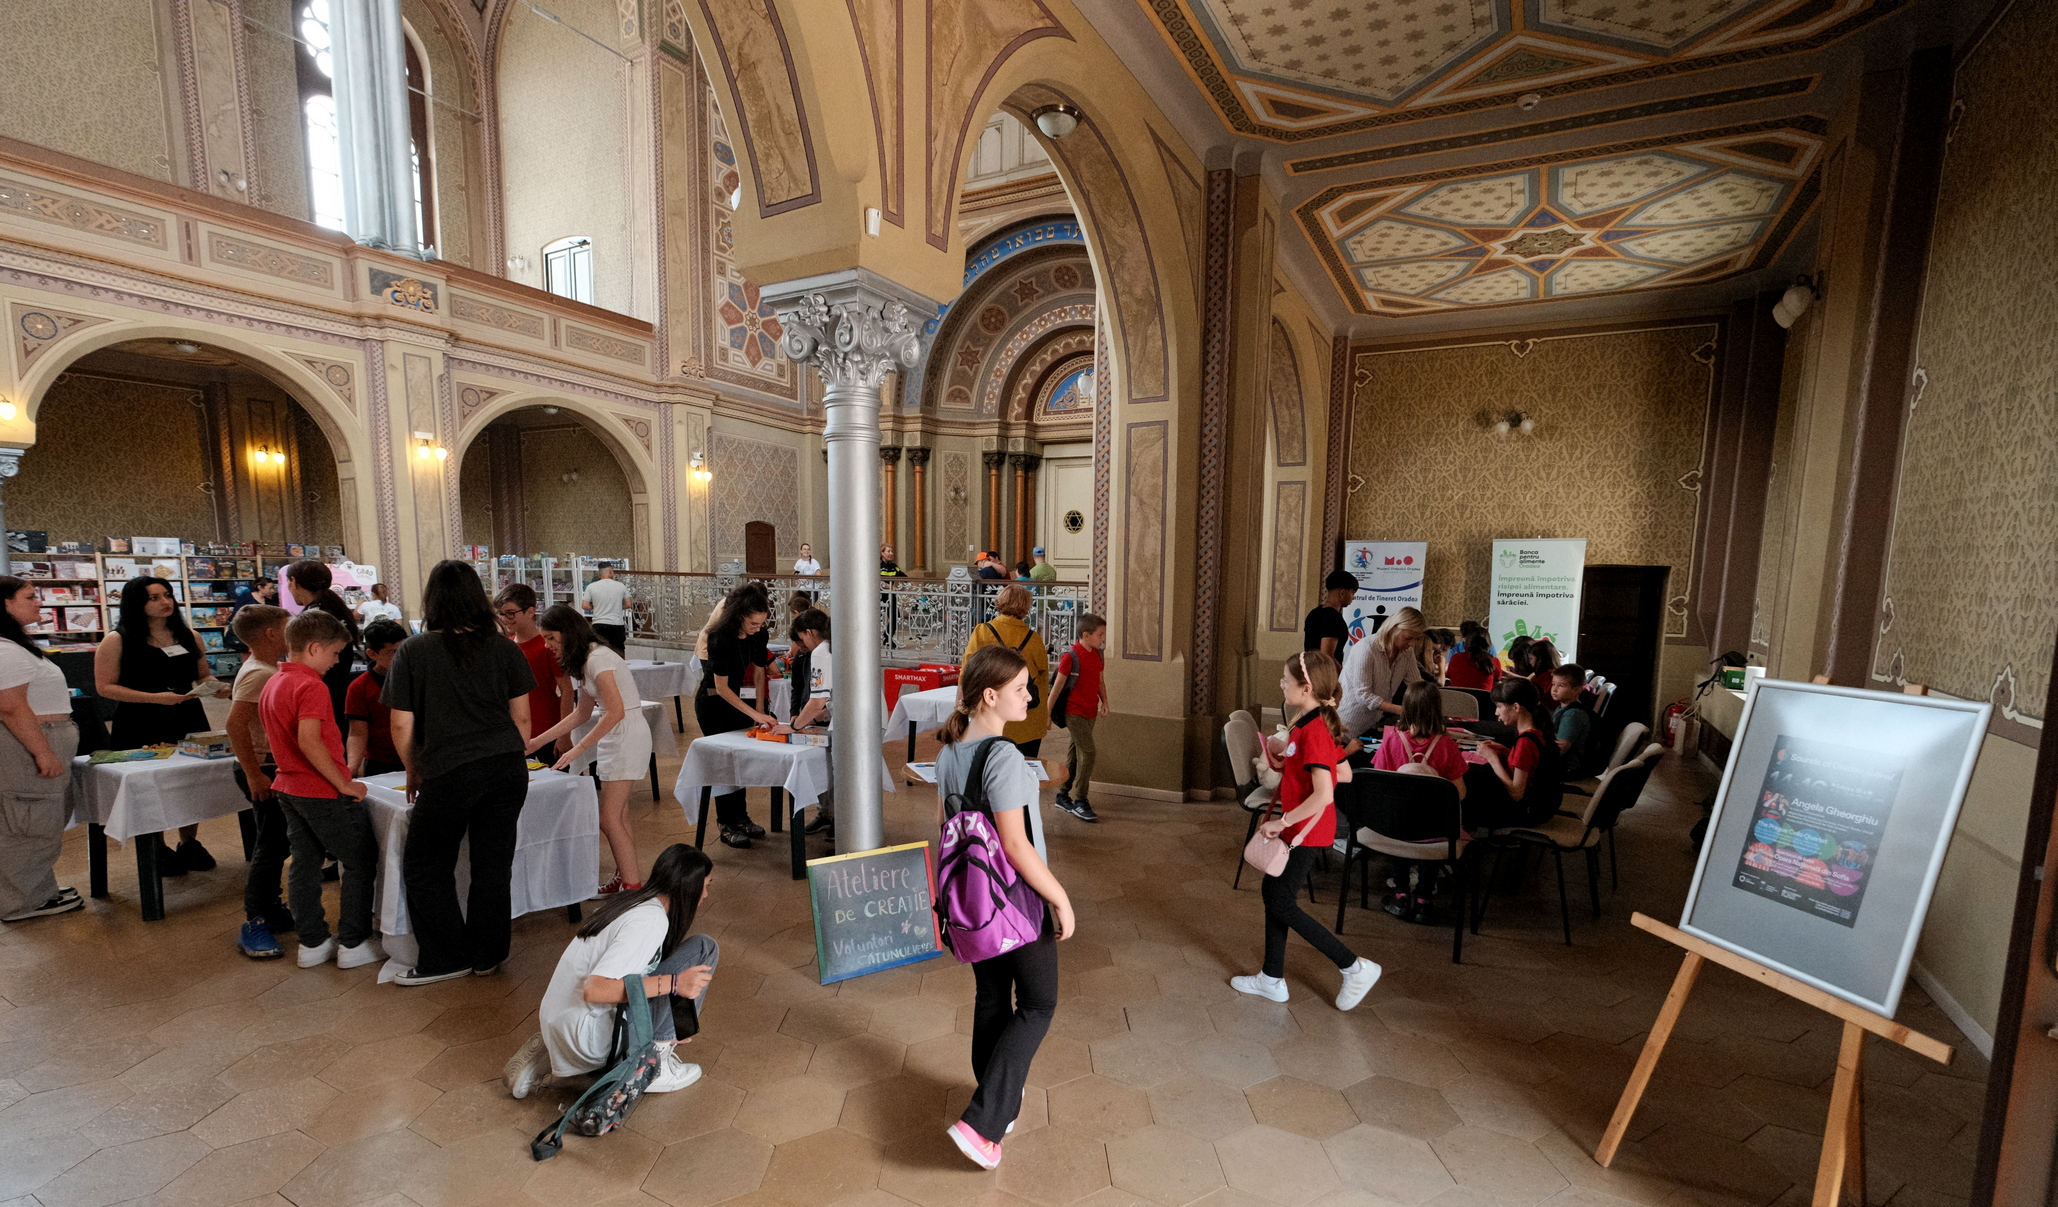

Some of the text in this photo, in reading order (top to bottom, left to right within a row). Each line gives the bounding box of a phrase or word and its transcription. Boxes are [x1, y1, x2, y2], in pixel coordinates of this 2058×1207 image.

[1498, 574, 1576, 583] Împreună împotriva
[1497, 583, 1522, 591] risipei
[1497, 590, 1575, 599] Împreună împotriva
[894, 674, 927, 682] SMARTMAX
[1790, 753, 1820, 766] Sounds
[1821, 759, 1832, 768] of
[1790, 797, 1824, 813] Angela
[1825, 806, 1879, 826] Gheorghiu
[1757, 819, 1768, 828] The
[1774, 854, 1792, 865] Opera
[1831, 871, 1850, 881] Sofia
[827, 863, 910, 900] Ateliere
[833, 930, 894, 958] Voluntari
